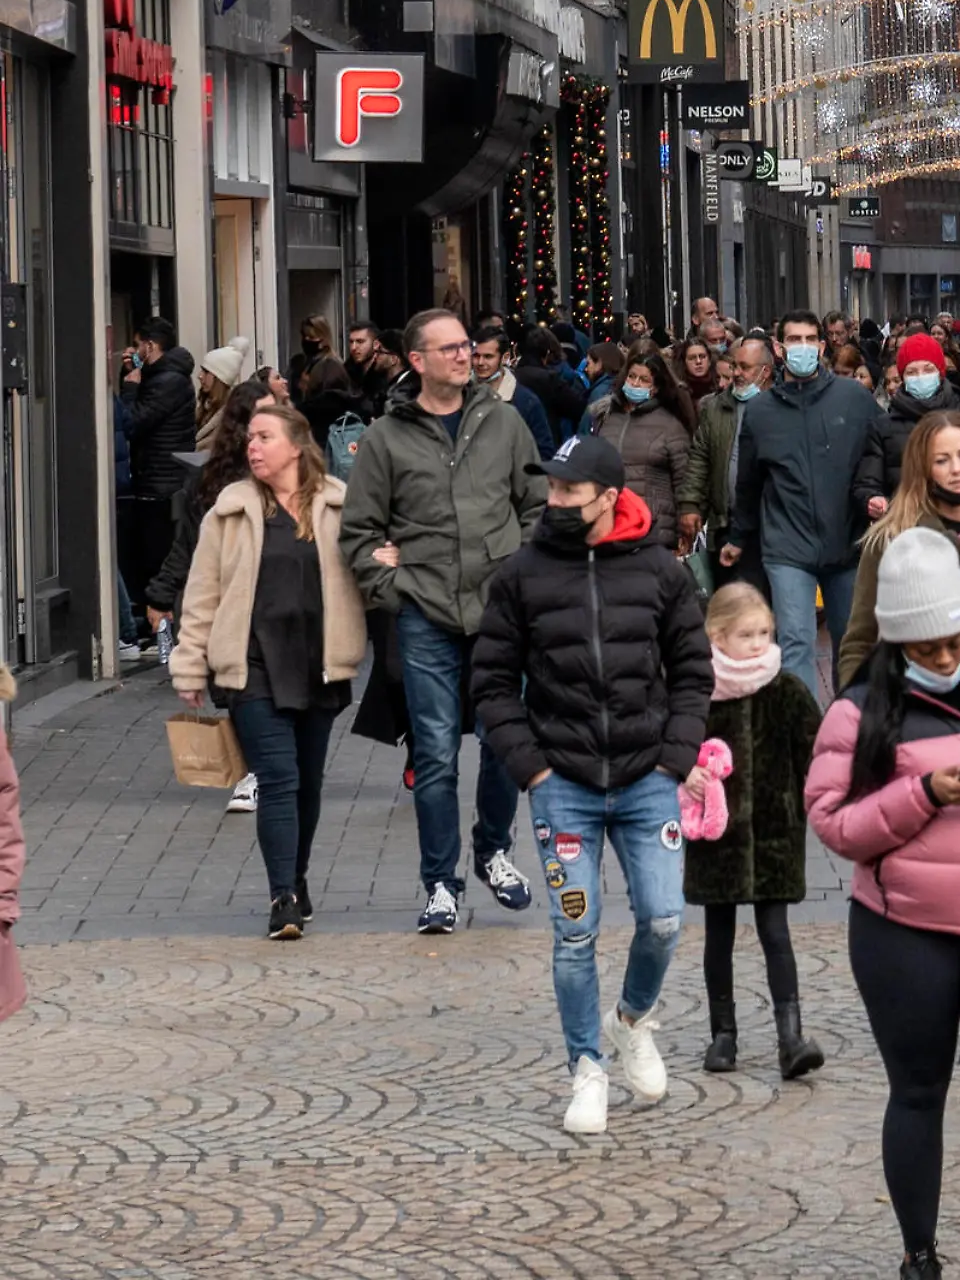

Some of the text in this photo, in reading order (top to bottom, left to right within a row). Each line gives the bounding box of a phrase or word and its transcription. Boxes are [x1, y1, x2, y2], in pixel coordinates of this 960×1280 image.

[688, 105, 745, 118] NELSON
[719, 155, 751, 166] ONLY
[705, 153, 719, 222] MANFIELD
